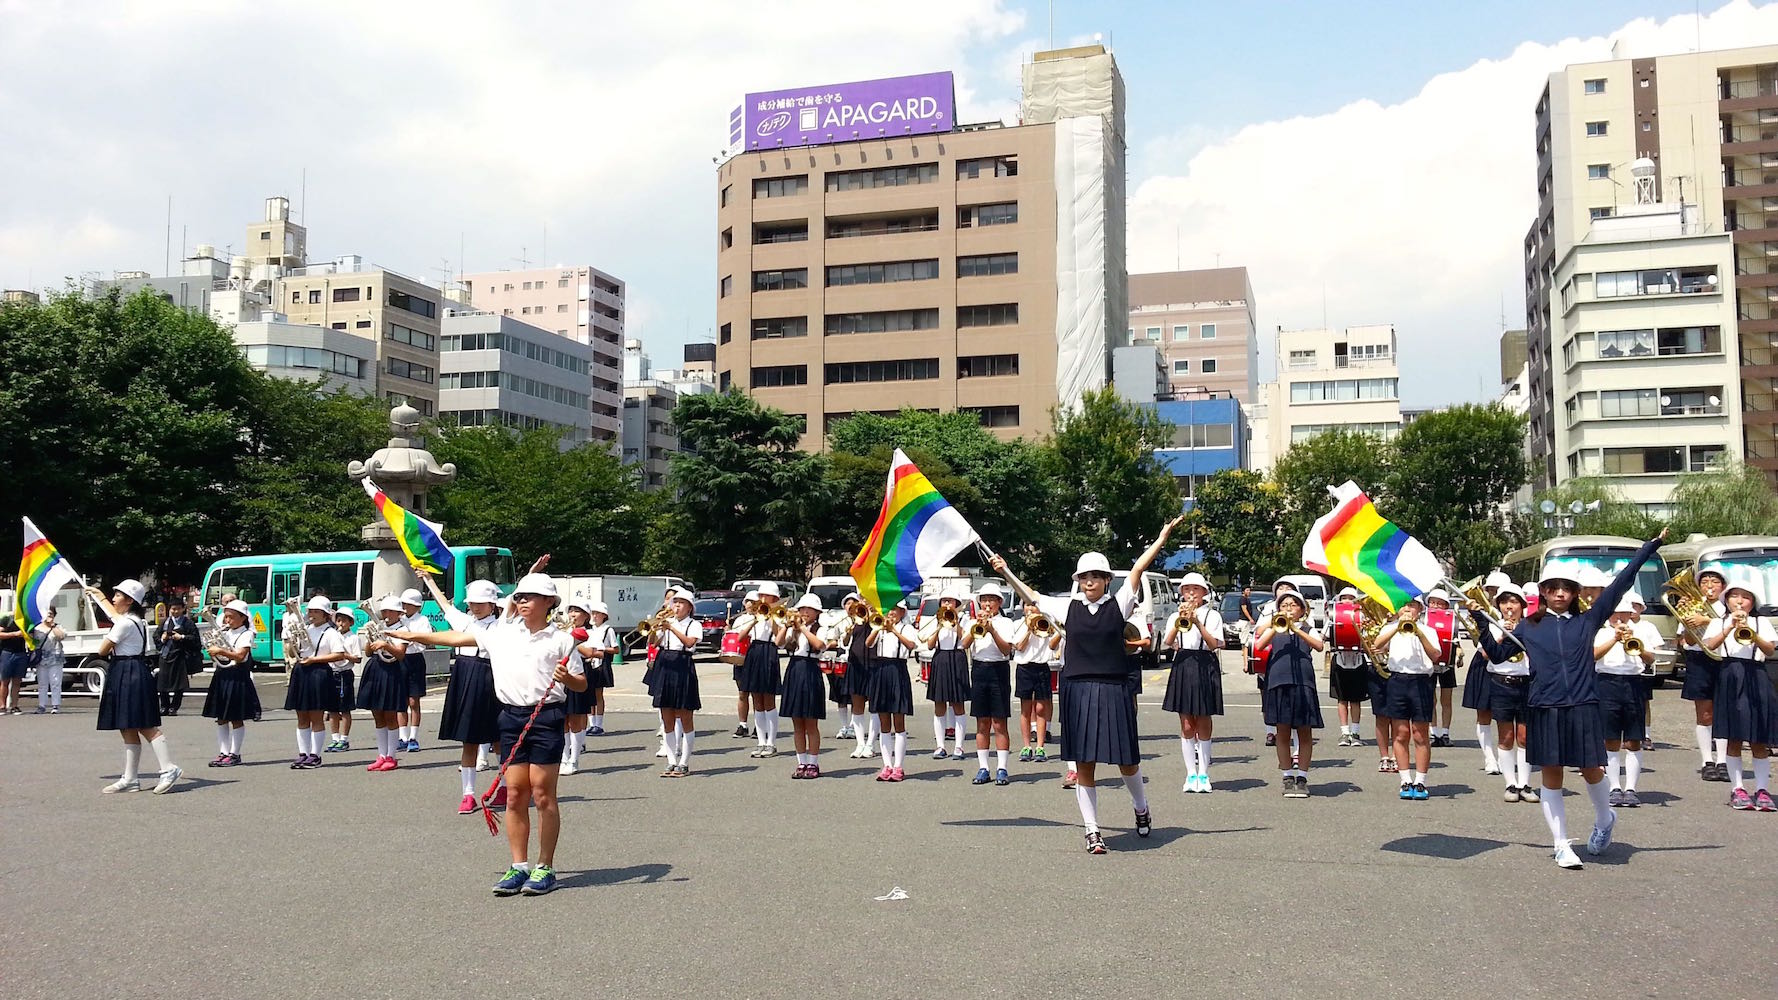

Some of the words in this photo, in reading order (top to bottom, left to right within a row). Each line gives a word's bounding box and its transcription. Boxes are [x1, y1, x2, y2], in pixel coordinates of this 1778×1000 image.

[758, 93, 843, 112] 成分補給で歯を守る
[822, 96, 937, 128] APAGARD
[762, 115, 787, 133] ナノテク
